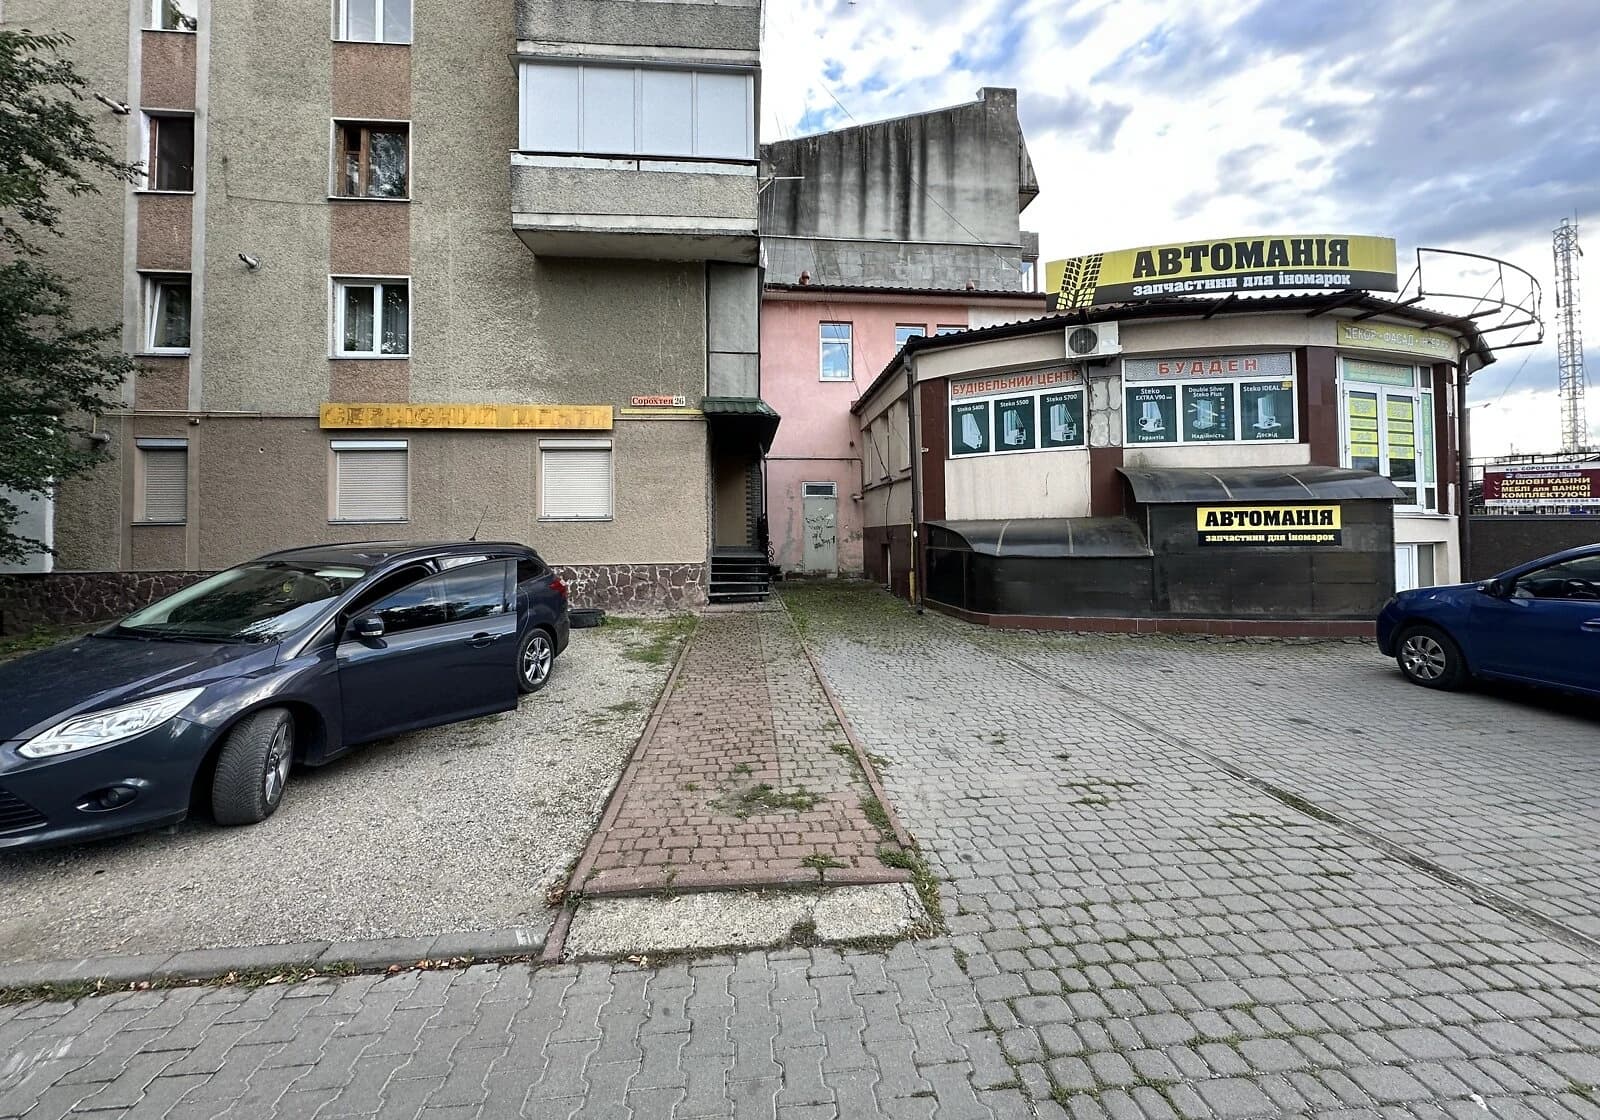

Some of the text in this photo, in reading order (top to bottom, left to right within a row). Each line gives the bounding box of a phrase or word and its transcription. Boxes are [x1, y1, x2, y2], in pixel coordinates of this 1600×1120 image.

[1133, 239, 1349, 279] АВТОМАНІЯ
[1133, 271, 1350, 297] запчастини для іномарок
[1158, 359, 1257, 375] БУДДЕН
[1037, 369, 1079, 385] ЦЕНТР
[1140, 387, 1161, 395] Steko
[1501, 478, 1544, 486] ДУШОВІ
[1205, 509, 1334, 527] АВТОМАНІЯ
[1205, 534, 1265, 542] запчастини
[1267, 534, 1286, 542] для
